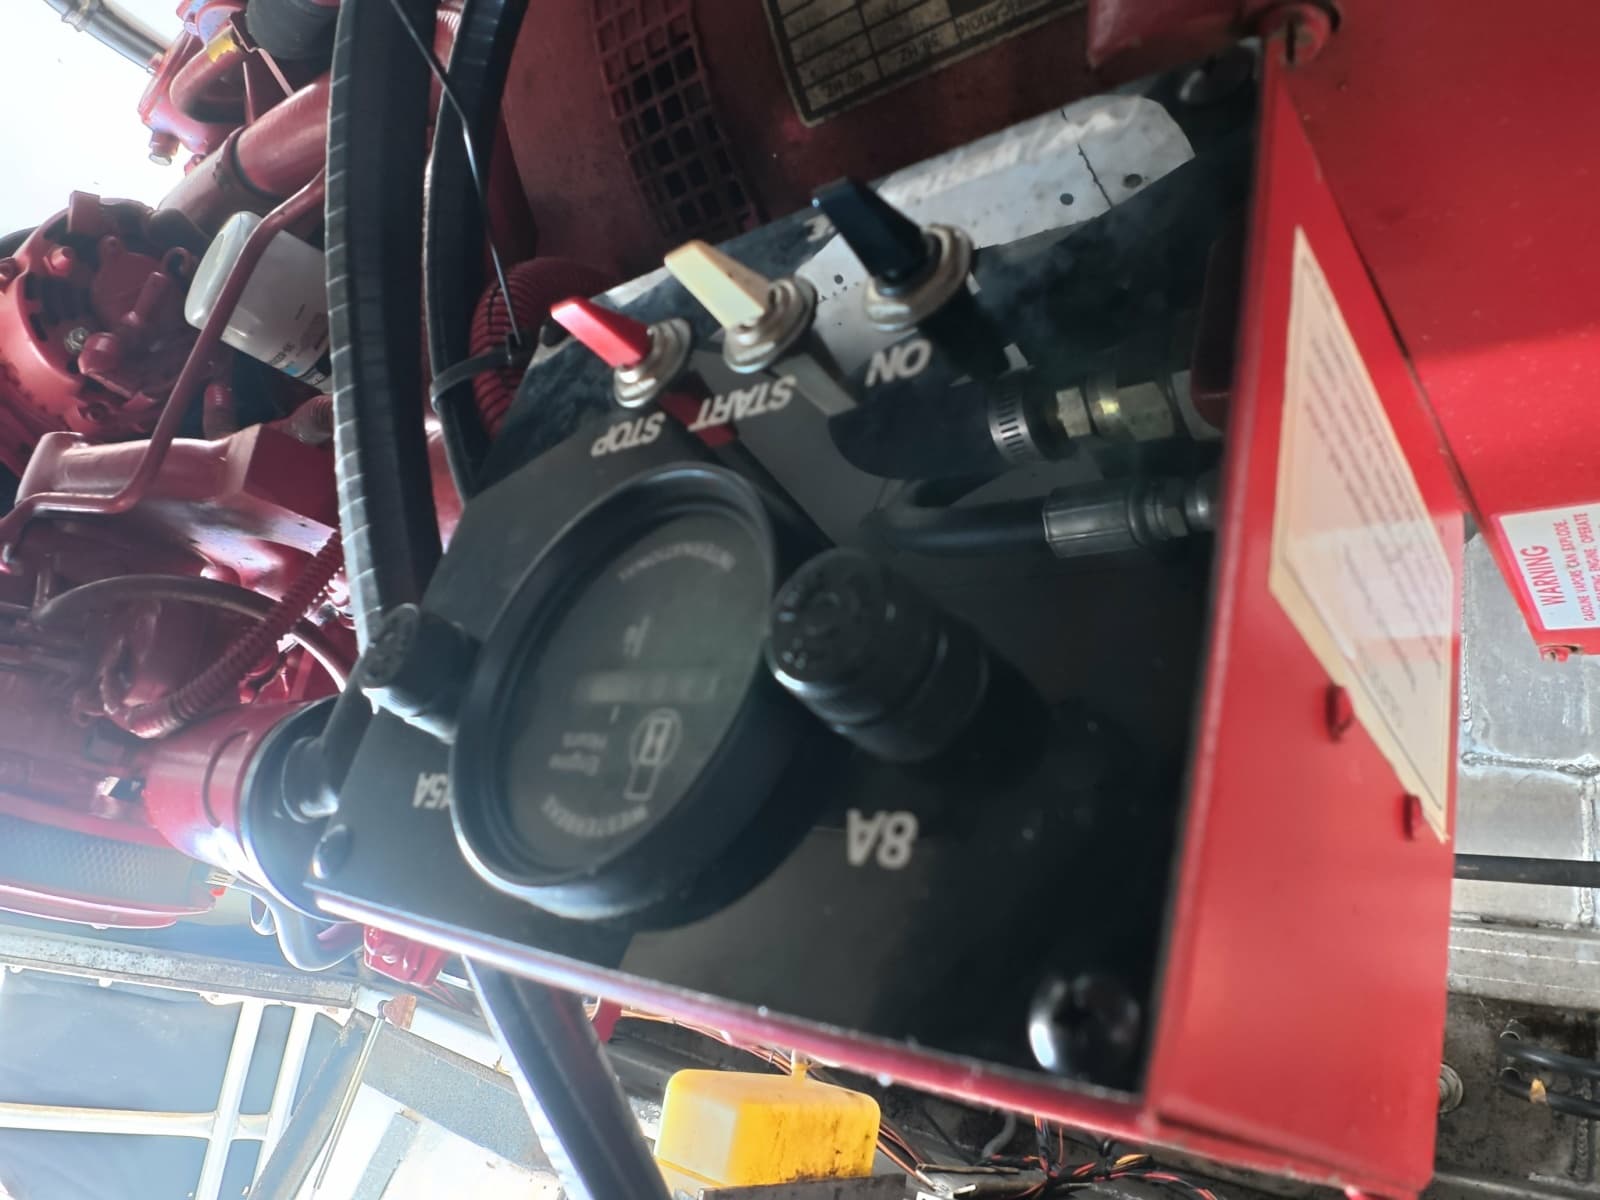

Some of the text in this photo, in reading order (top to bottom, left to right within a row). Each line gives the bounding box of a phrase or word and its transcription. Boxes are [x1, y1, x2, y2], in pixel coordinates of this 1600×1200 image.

[865, 338, 932, 387] ON
[687, 375, 796, 432] START
[590, 412, 666, 457] STOP
[1573, 512, 1595, 543] OPERATE
[1520, 545, 1567, 606] WARNING
[1564, 553, 1580, 568] CAN
[1569, 569, 1587, 593] VAPORS
[1577, 595, 1596, 621] GASOLINE
[847, 808, 919, 870] 8A
